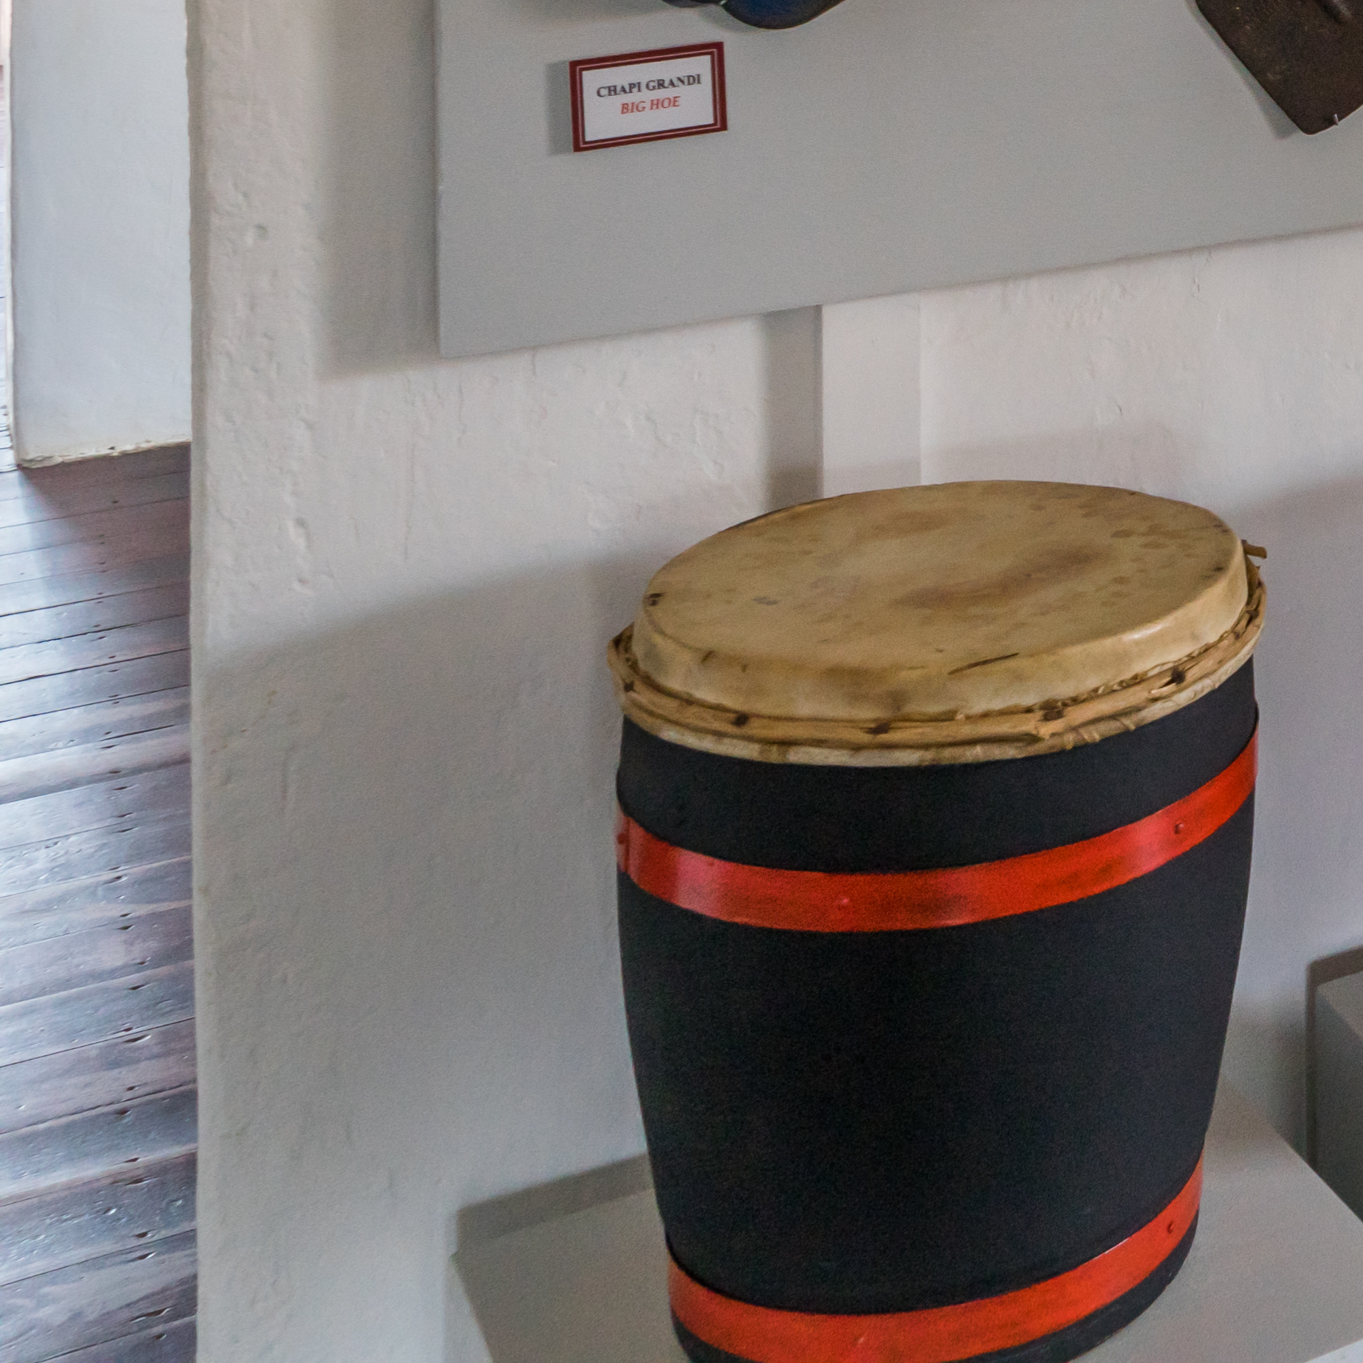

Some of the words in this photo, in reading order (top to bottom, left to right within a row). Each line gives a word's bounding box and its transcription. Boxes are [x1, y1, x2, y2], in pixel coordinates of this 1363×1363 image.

[596, 82, 642, 97] CHAPI
[646, 73, 701, 91] GRANDI
[620, 100, 646, 114] BIG
[650, 96, 681, 111] HOE
